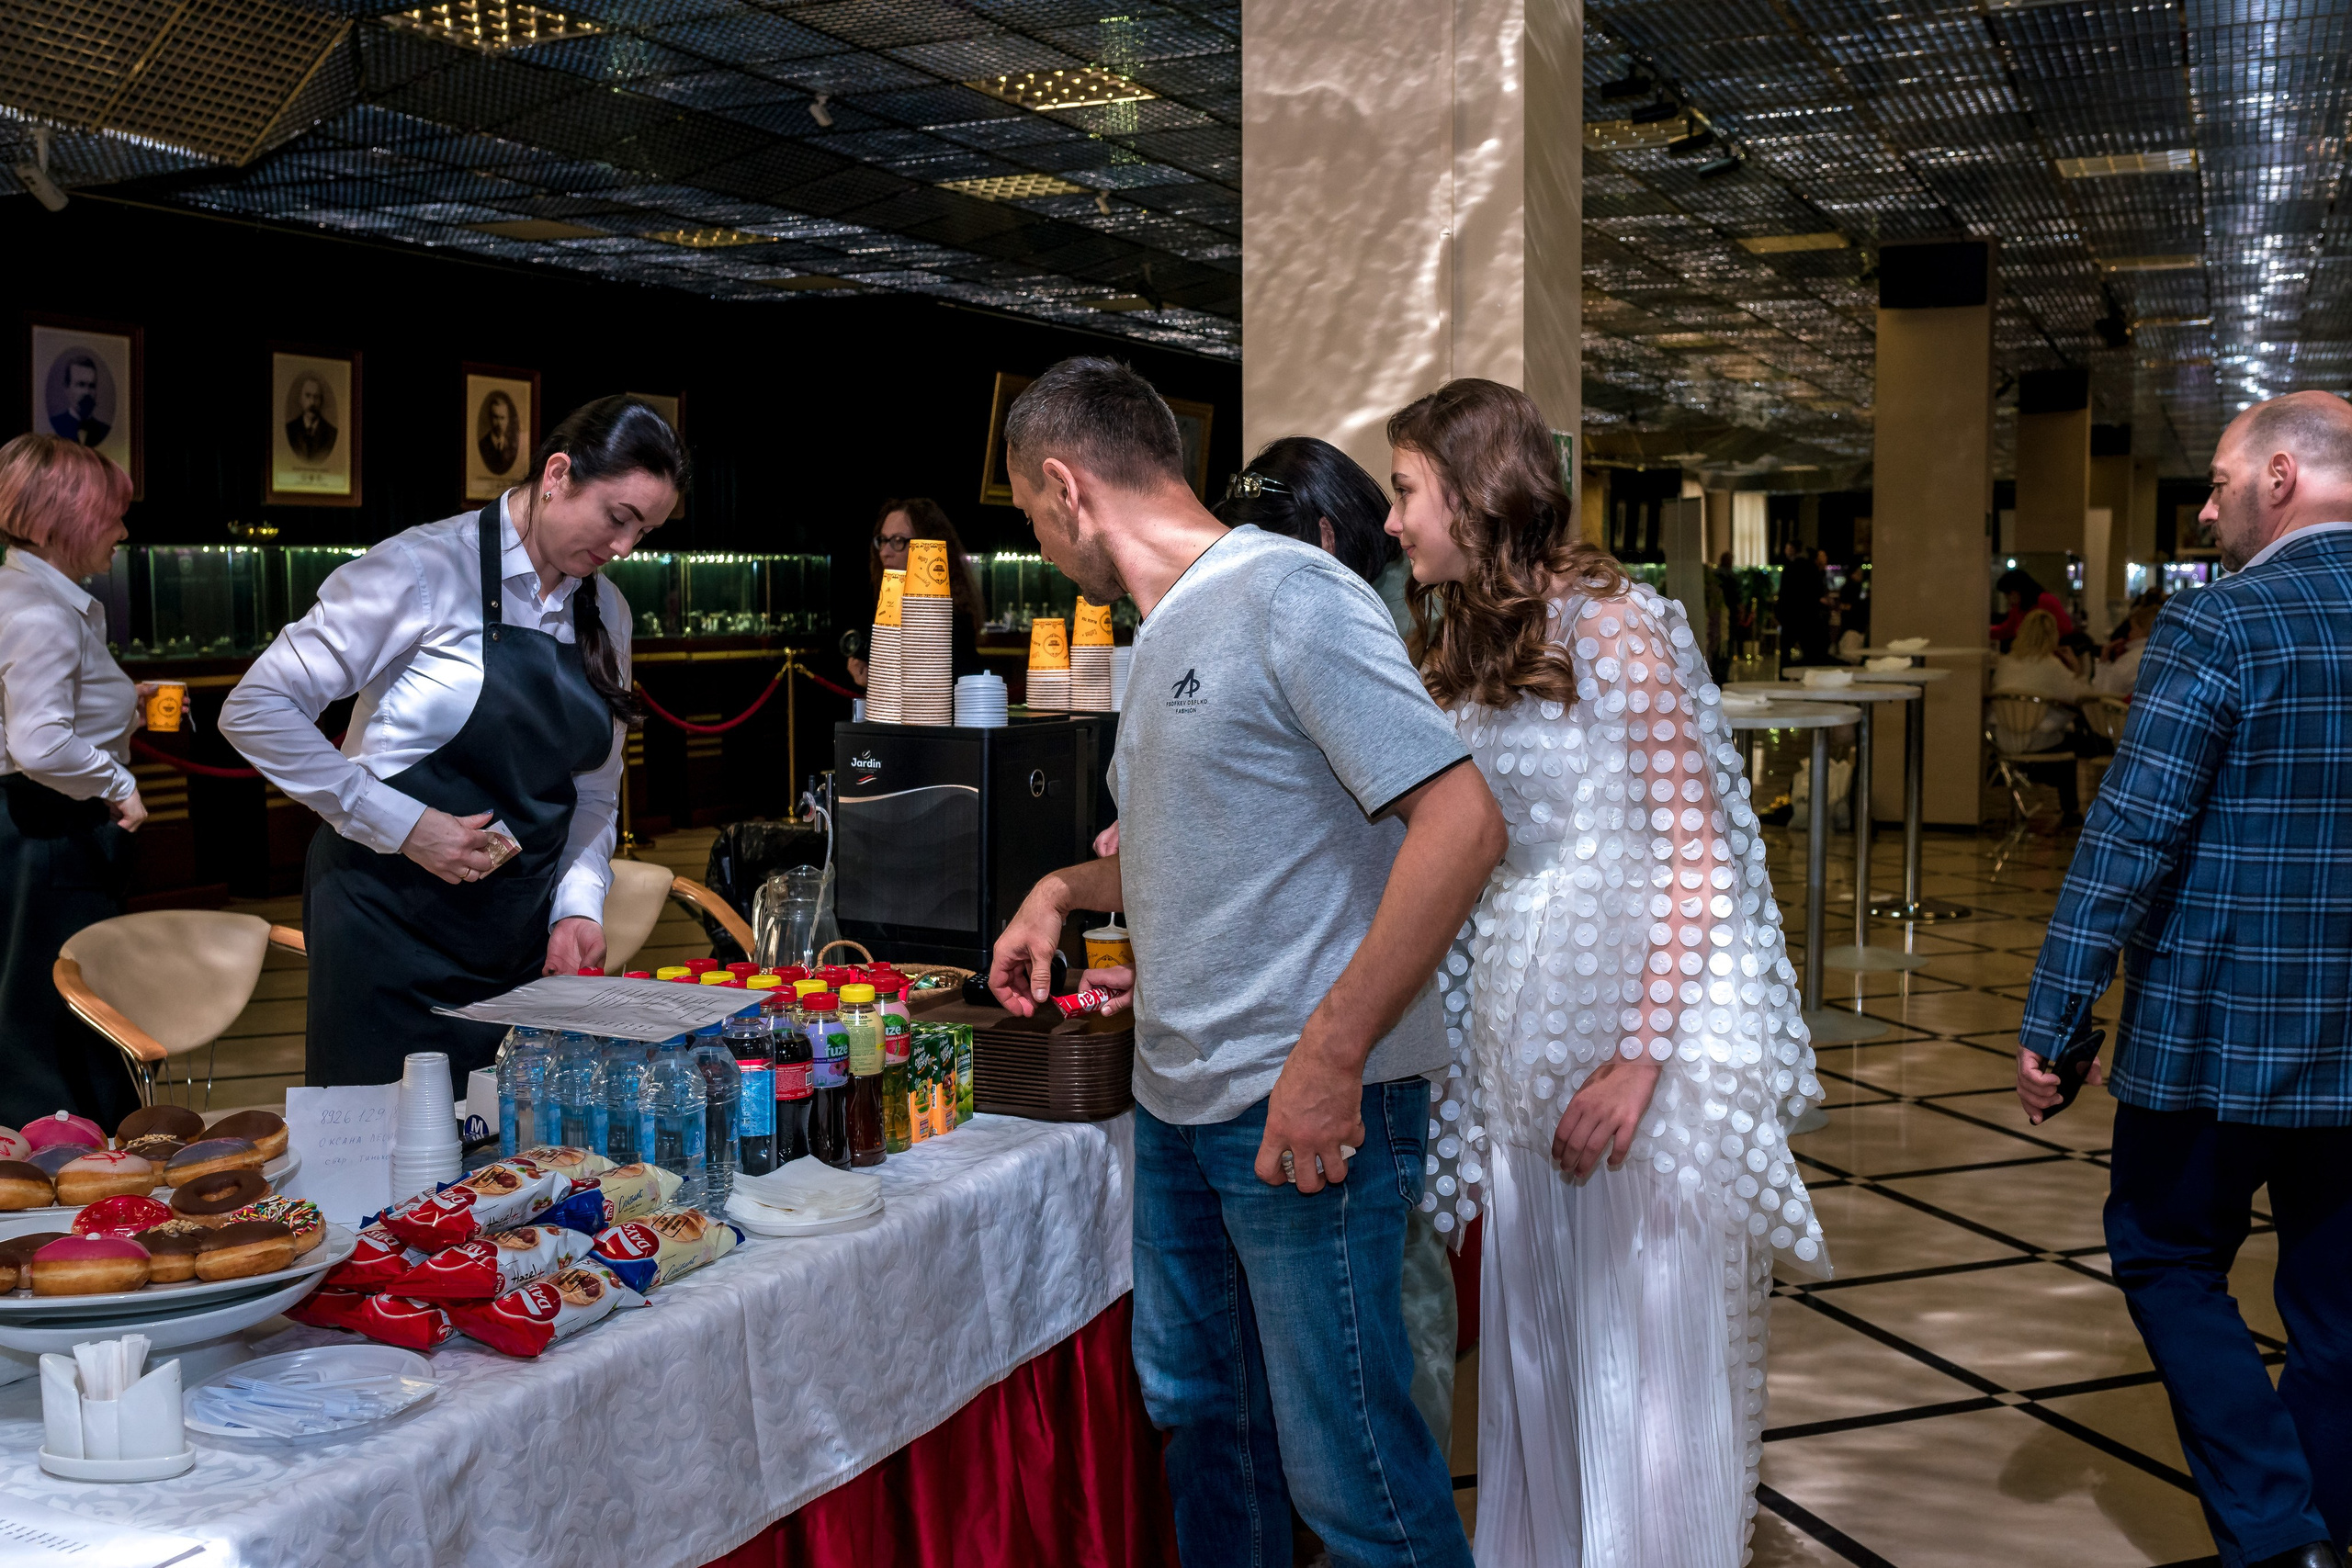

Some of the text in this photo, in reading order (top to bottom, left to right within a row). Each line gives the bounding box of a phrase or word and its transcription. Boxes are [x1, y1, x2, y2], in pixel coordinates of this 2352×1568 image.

[851, 757, 882, 769] Jardin
[824, 1043, 848, 1058] fuze
[321, 1109, 352, 1125] 8926
[358, 1107, 386, 1122] 129
[319, 1135, 362, 1148] ОКСАНА
[600, 1223, 652, 1257] 7 DAYS
